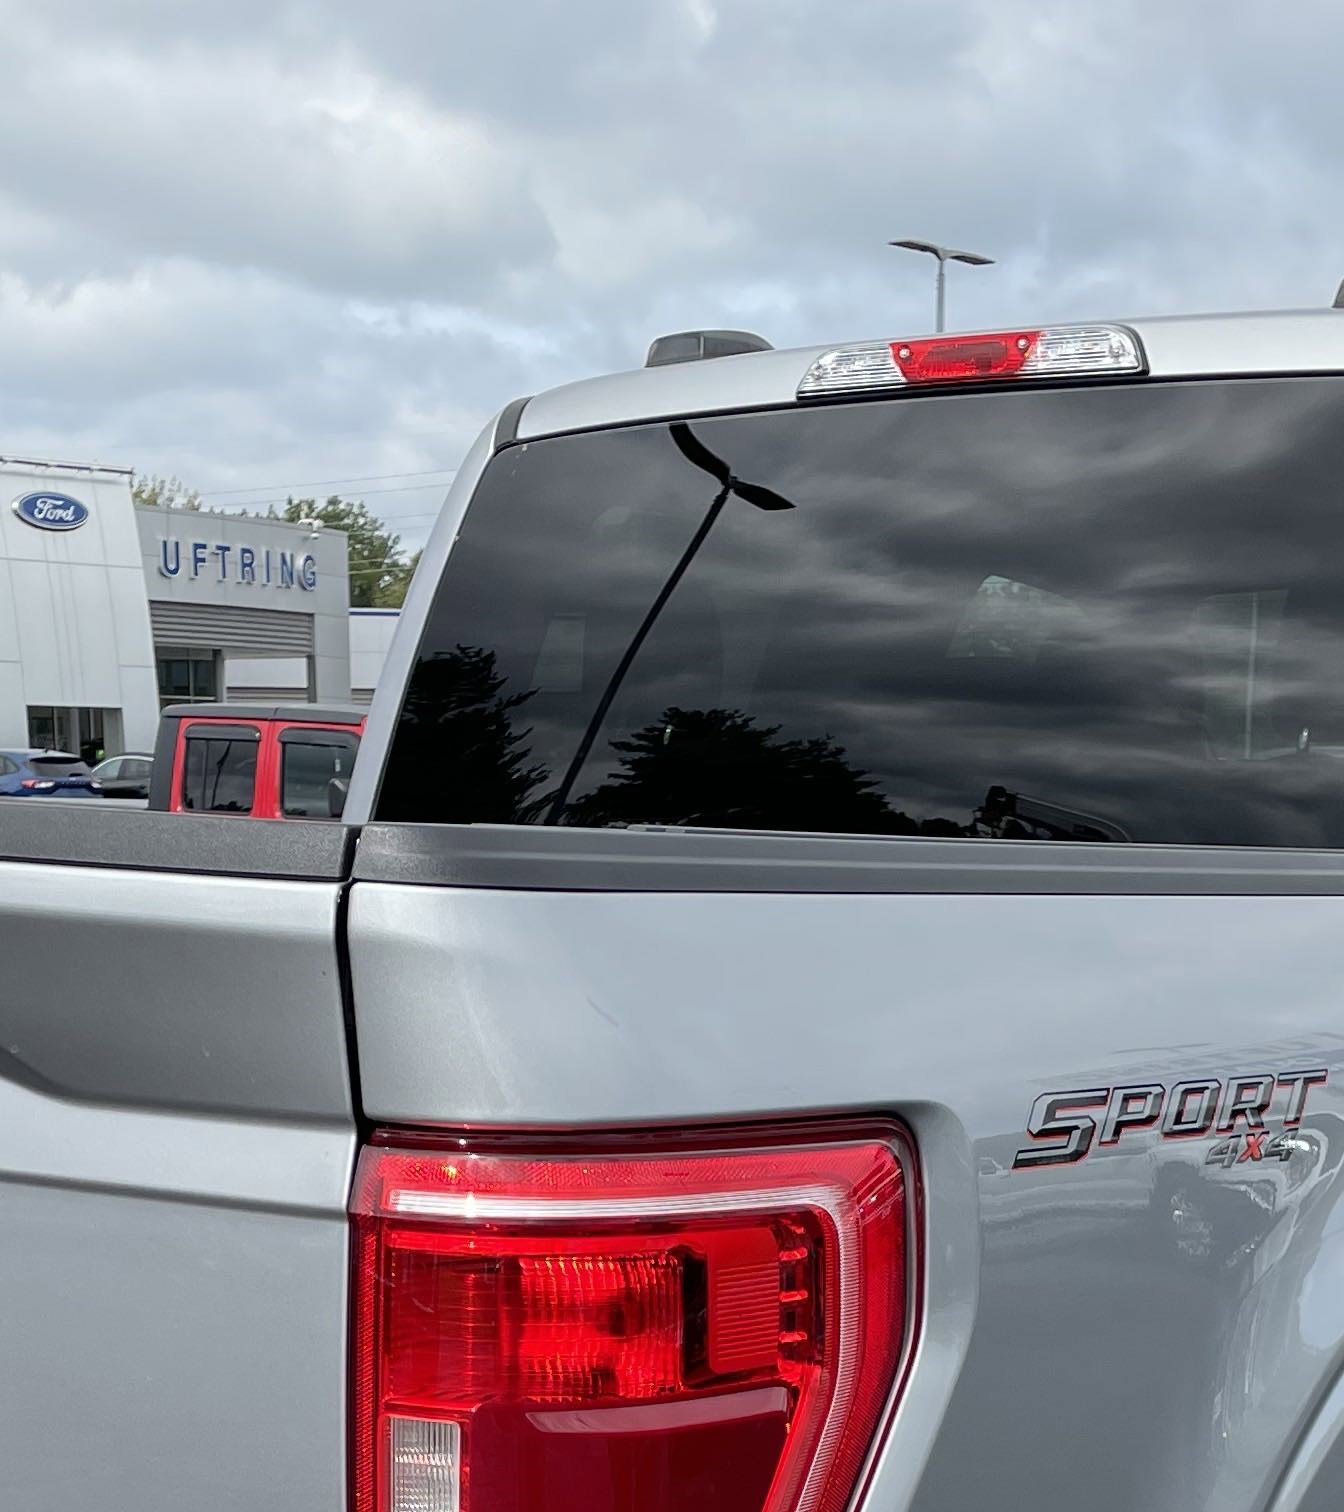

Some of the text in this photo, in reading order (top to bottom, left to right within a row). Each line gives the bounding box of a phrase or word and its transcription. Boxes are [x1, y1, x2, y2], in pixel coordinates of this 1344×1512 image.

[34, 498, 75, 521] Ford
[160, 540, 316, 592] UFTRING
[1012, 1069, 1328, 1169] SPORT
